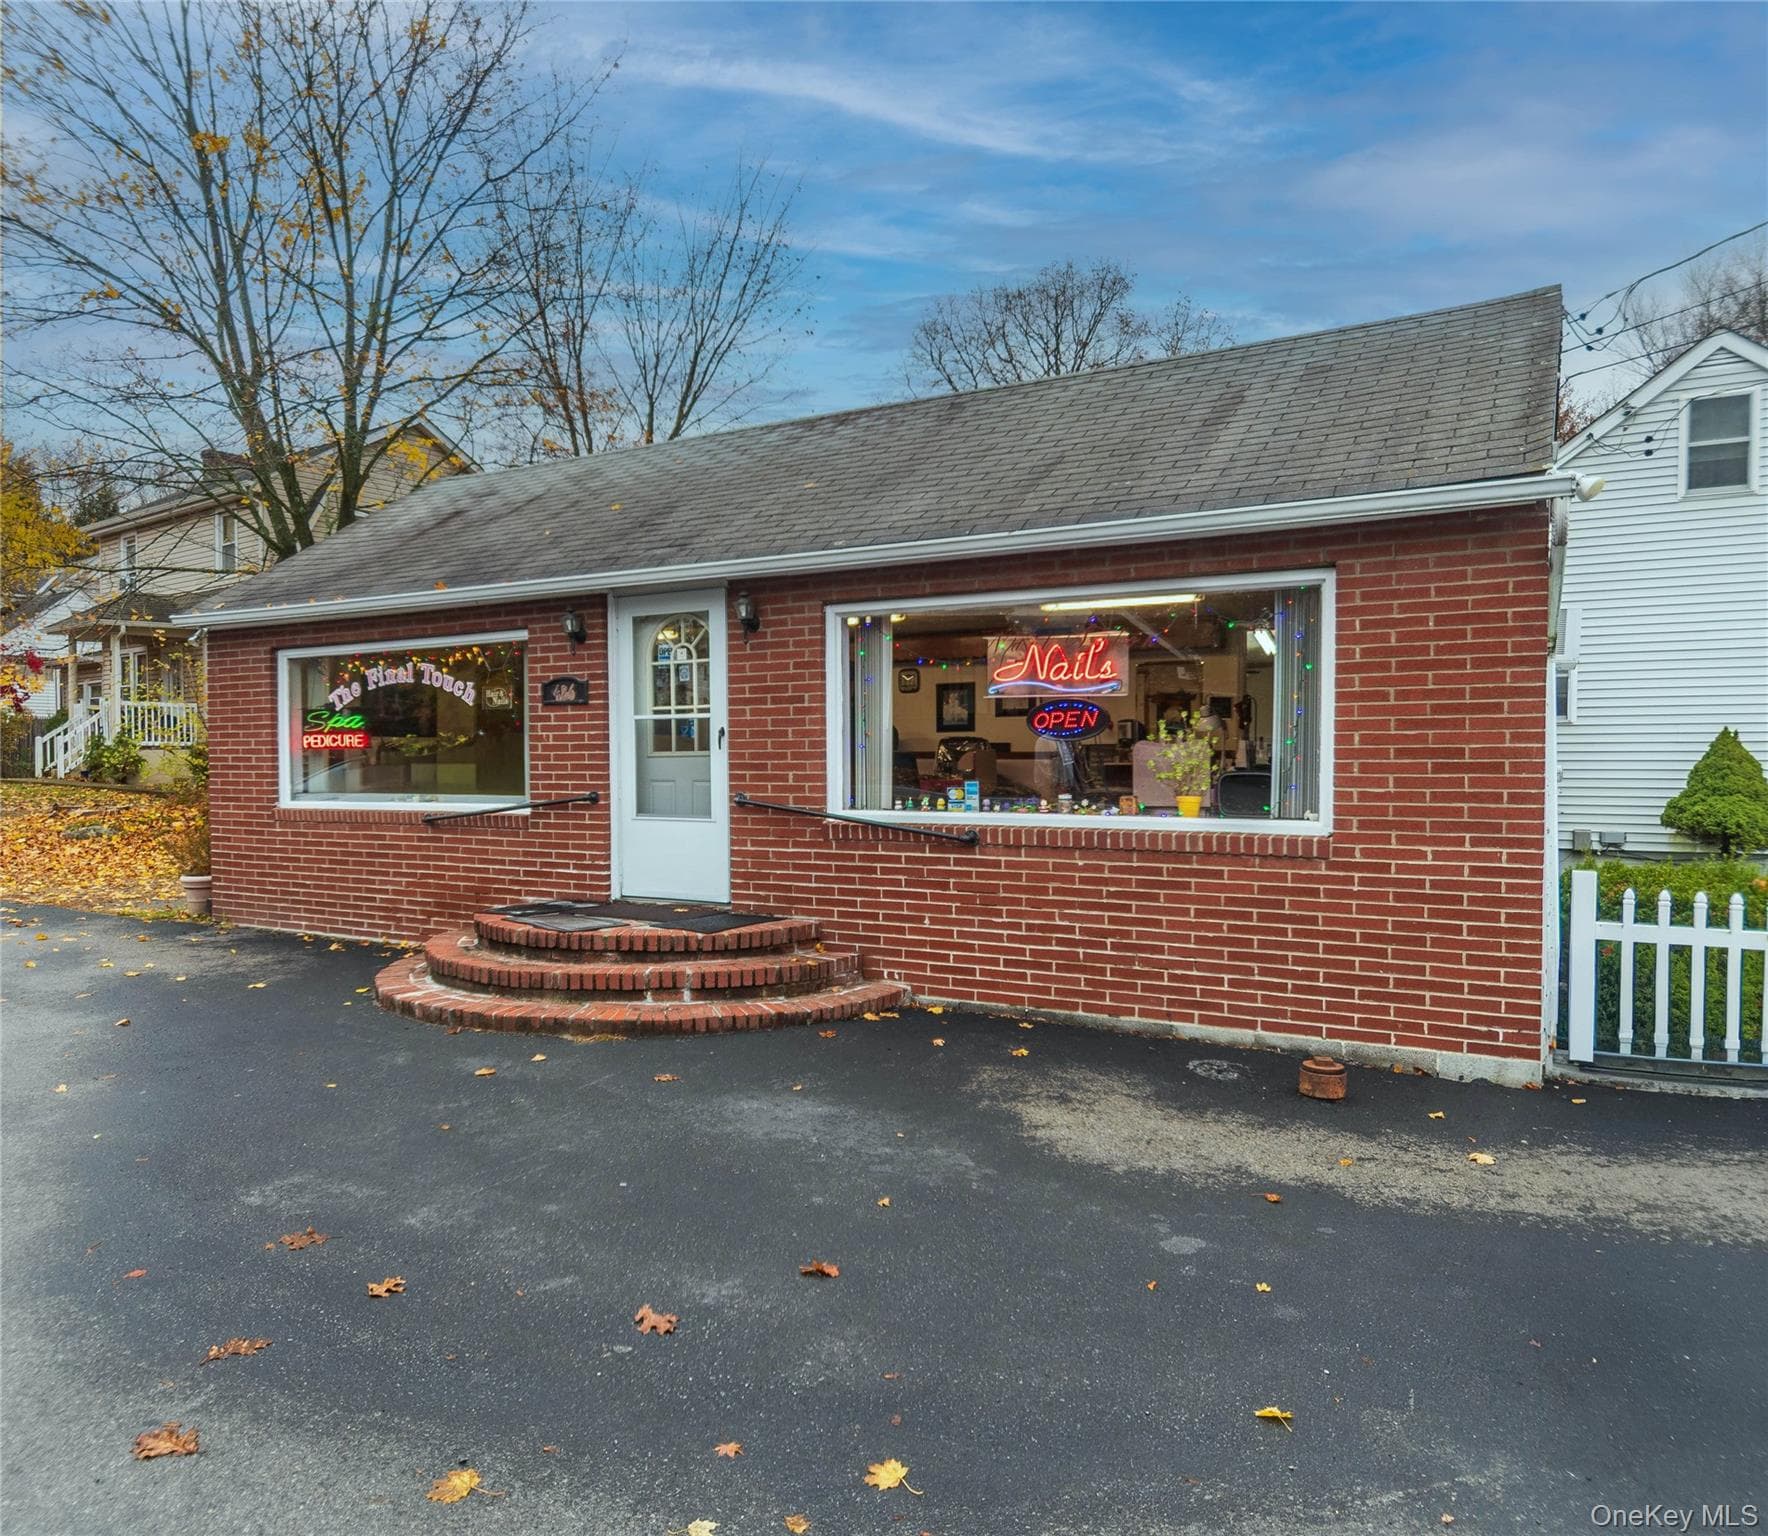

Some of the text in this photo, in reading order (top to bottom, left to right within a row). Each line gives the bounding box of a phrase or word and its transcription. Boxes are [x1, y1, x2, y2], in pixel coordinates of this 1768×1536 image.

[993, 637, 1118, 681] Nail's
[328, 661, 477, 711] The Final Touch
[304, 710, 366, 733] Spa
[1033, 709, 1100, 729] OPEN
[303, 734, 365, 749] PEDICURE
